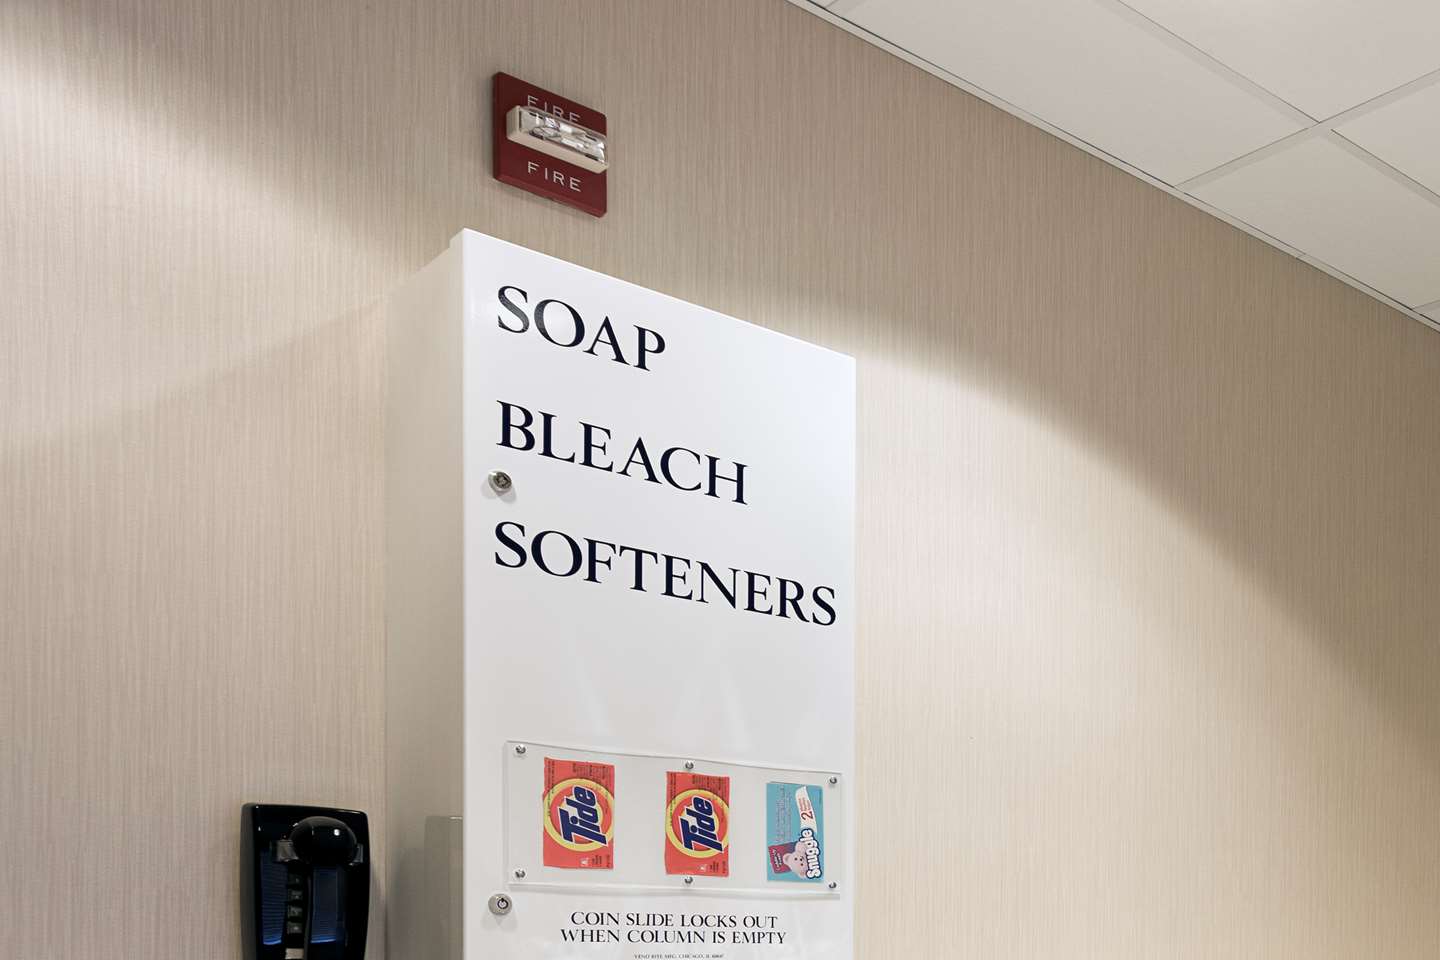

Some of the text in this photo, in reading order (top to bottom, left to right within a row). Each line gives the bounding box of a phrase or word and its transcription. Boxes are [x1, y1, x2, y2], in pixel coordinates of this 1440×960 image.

[527, 95, 581, 123] FIRE
[527, 161, 582, 192] FIRE
[497, 285, 666, 372] SOAP
[496, 400, 748, 506] BLEACH
[494, 521, 837, 627] SOFTENERS
[558, 785, 608, 846] Tide
[679, 796, 724, 853] Tide
[799, 828, 822, 879] Snuggle
[560, 928, 787, 945] WHEN COLUMN IS EMPTY
[570, 911, 778, 929] COIN SLIDE LOCKS OUT
